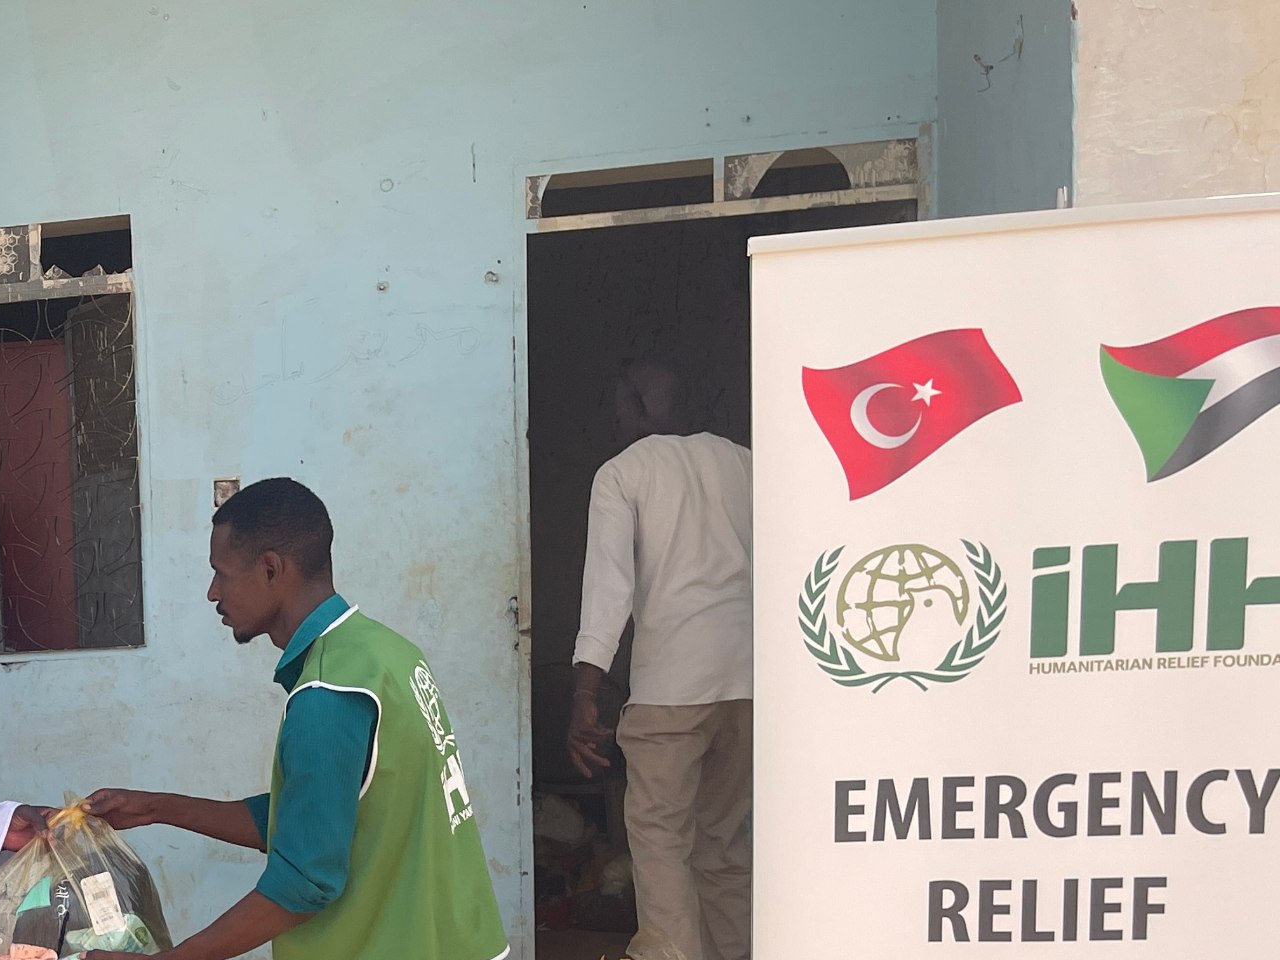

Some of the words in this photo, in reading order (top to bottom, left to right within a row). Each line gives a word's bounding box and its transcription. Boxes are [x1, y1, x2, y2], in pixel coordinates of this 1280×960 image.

[1029, 657, 1153, 675] HUMANITARIAN
[1157, 655, 1210, 670] RELIEF
[834, 768, 1280, 843] EMERGENCY
[927, 876, 1168, 943] RELIEF
